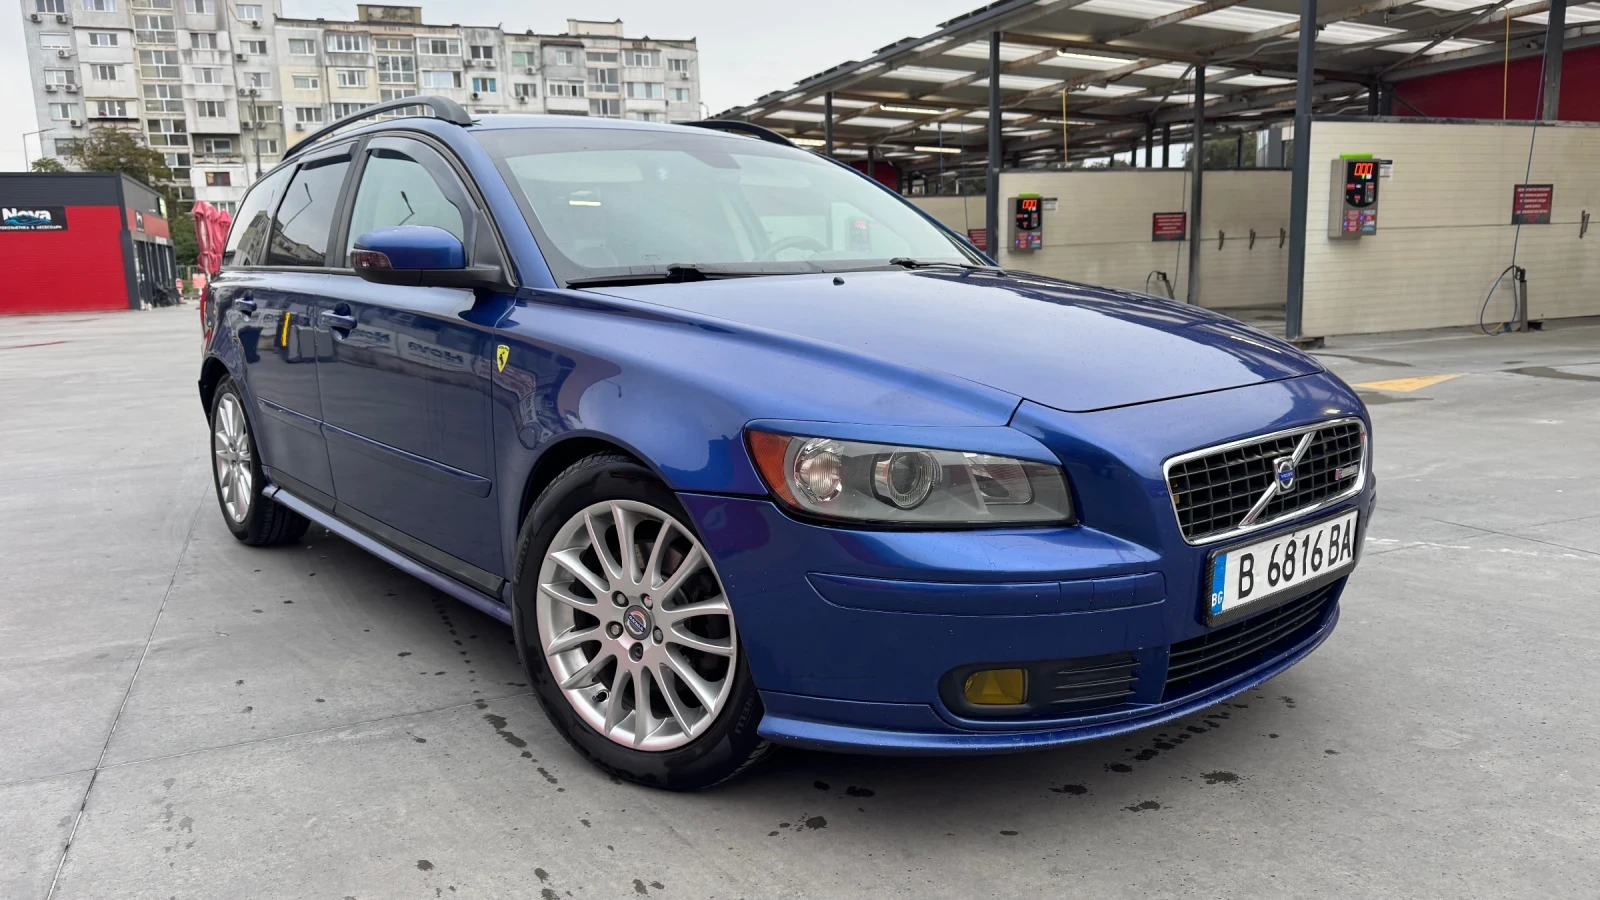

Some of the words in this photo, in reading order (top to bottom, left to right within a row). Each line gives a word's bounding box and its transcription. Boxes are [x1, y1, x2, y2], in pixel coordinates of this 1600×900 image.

[1238, 552, 1254, 600] B
[1267, 529, 1323, 587] 6816
[1328, 519, 1352, 567] BA
[1211, 591, 1223, 607] BG
